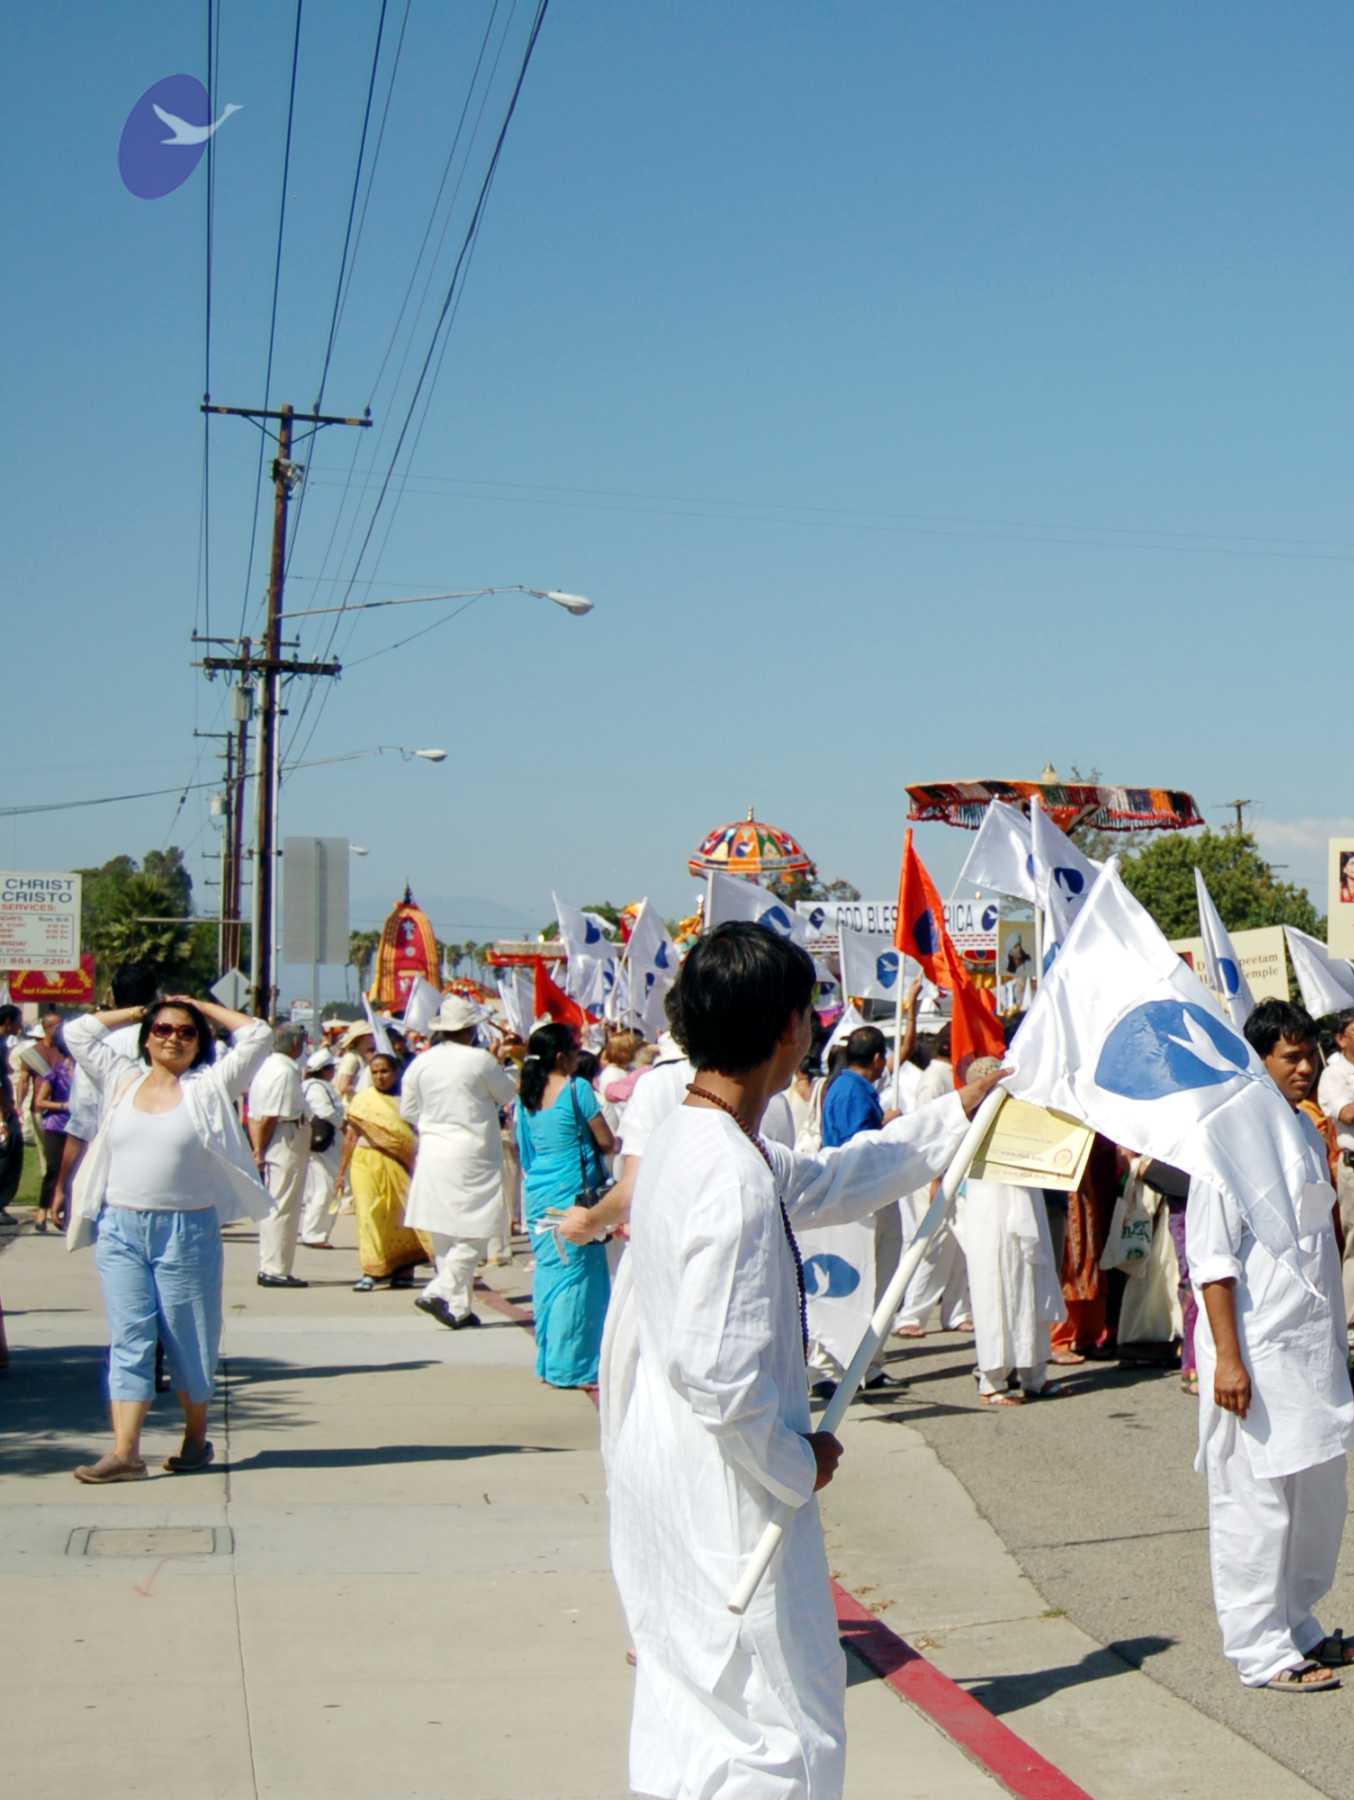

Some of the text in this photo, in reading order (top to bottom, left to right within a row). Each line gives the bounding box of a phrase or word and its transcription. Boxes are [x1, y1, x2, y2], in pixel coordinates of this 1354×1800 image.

[5, 878, 74, 891] CHRIST
[1, 891, 73, 903] CRISTO
[867, 905, 899, 935] BLES
